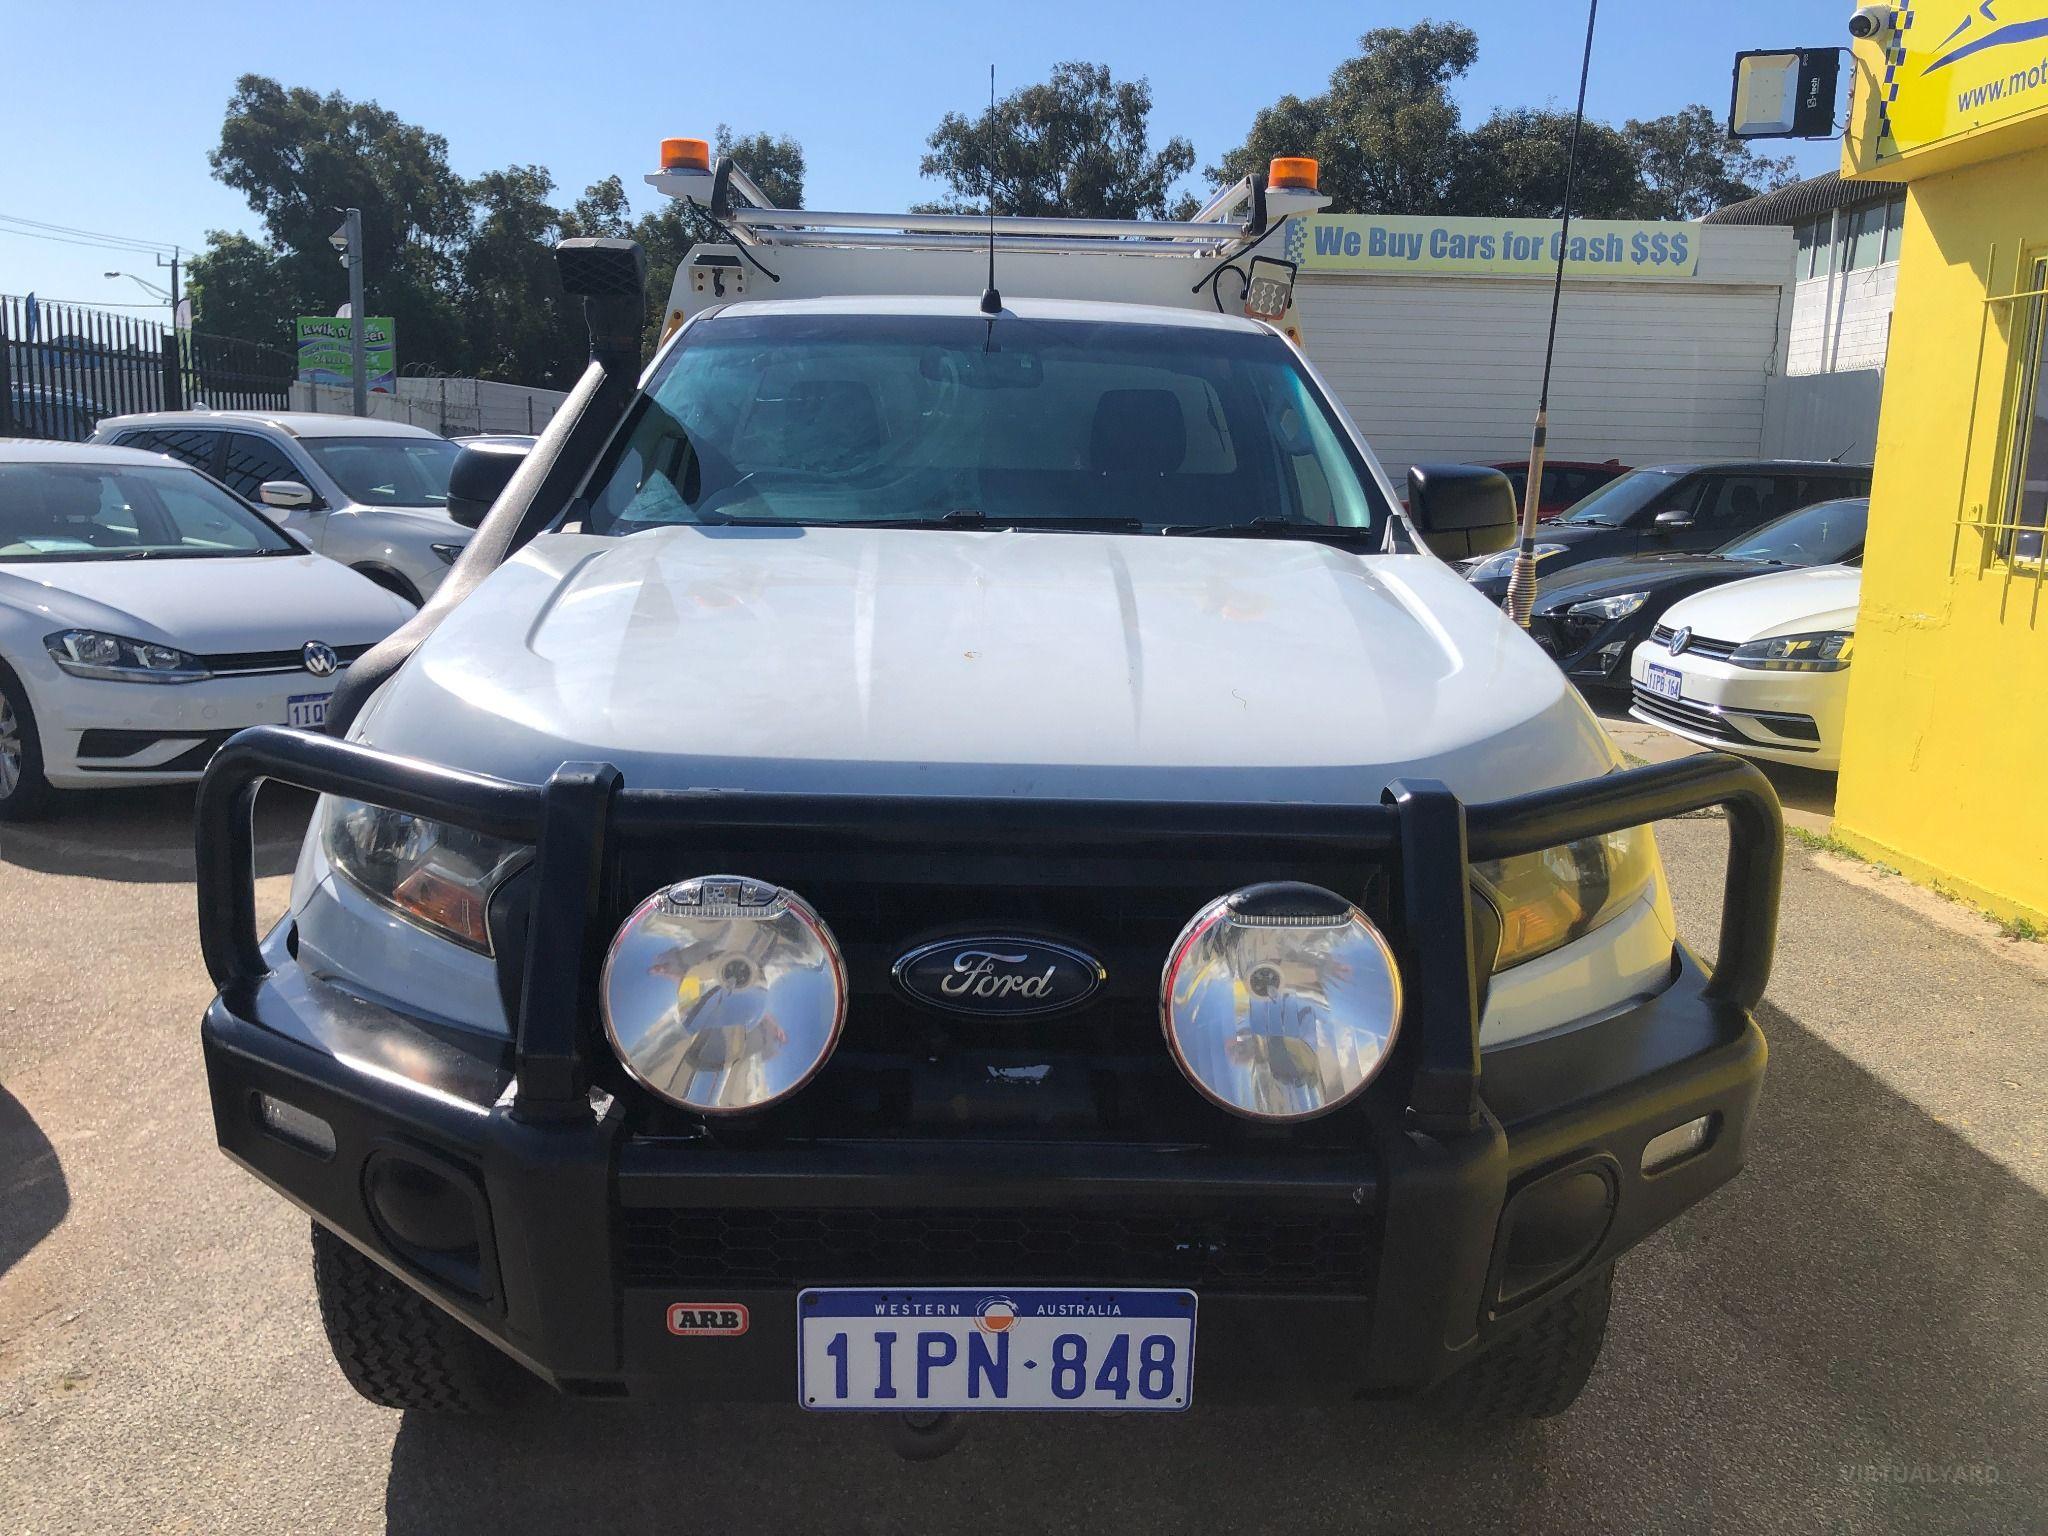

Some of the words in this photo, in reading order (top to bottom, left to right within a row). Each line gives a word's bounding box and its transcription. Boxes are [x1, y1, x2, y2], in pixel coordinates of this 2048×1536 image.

[1315, 225, 1361, 257] We
[1368, 228, 1423, 261] Buy
[1429, 228, 1495, 260] Cars
[1502, 231, 1545, 261] for
[1550, 232, 1623, 263] Cash
[1631, 231, 1688, 266] $$$
[941, 951, 1056, 998] Ford
[679, 1311, 739, 1328] ARB
[874, 1305, 959, 1316] WESTERN
[1036, 1305, 1122, 1316] AUSTRALIA
[1050, 1333, 1177, 1400] 848
